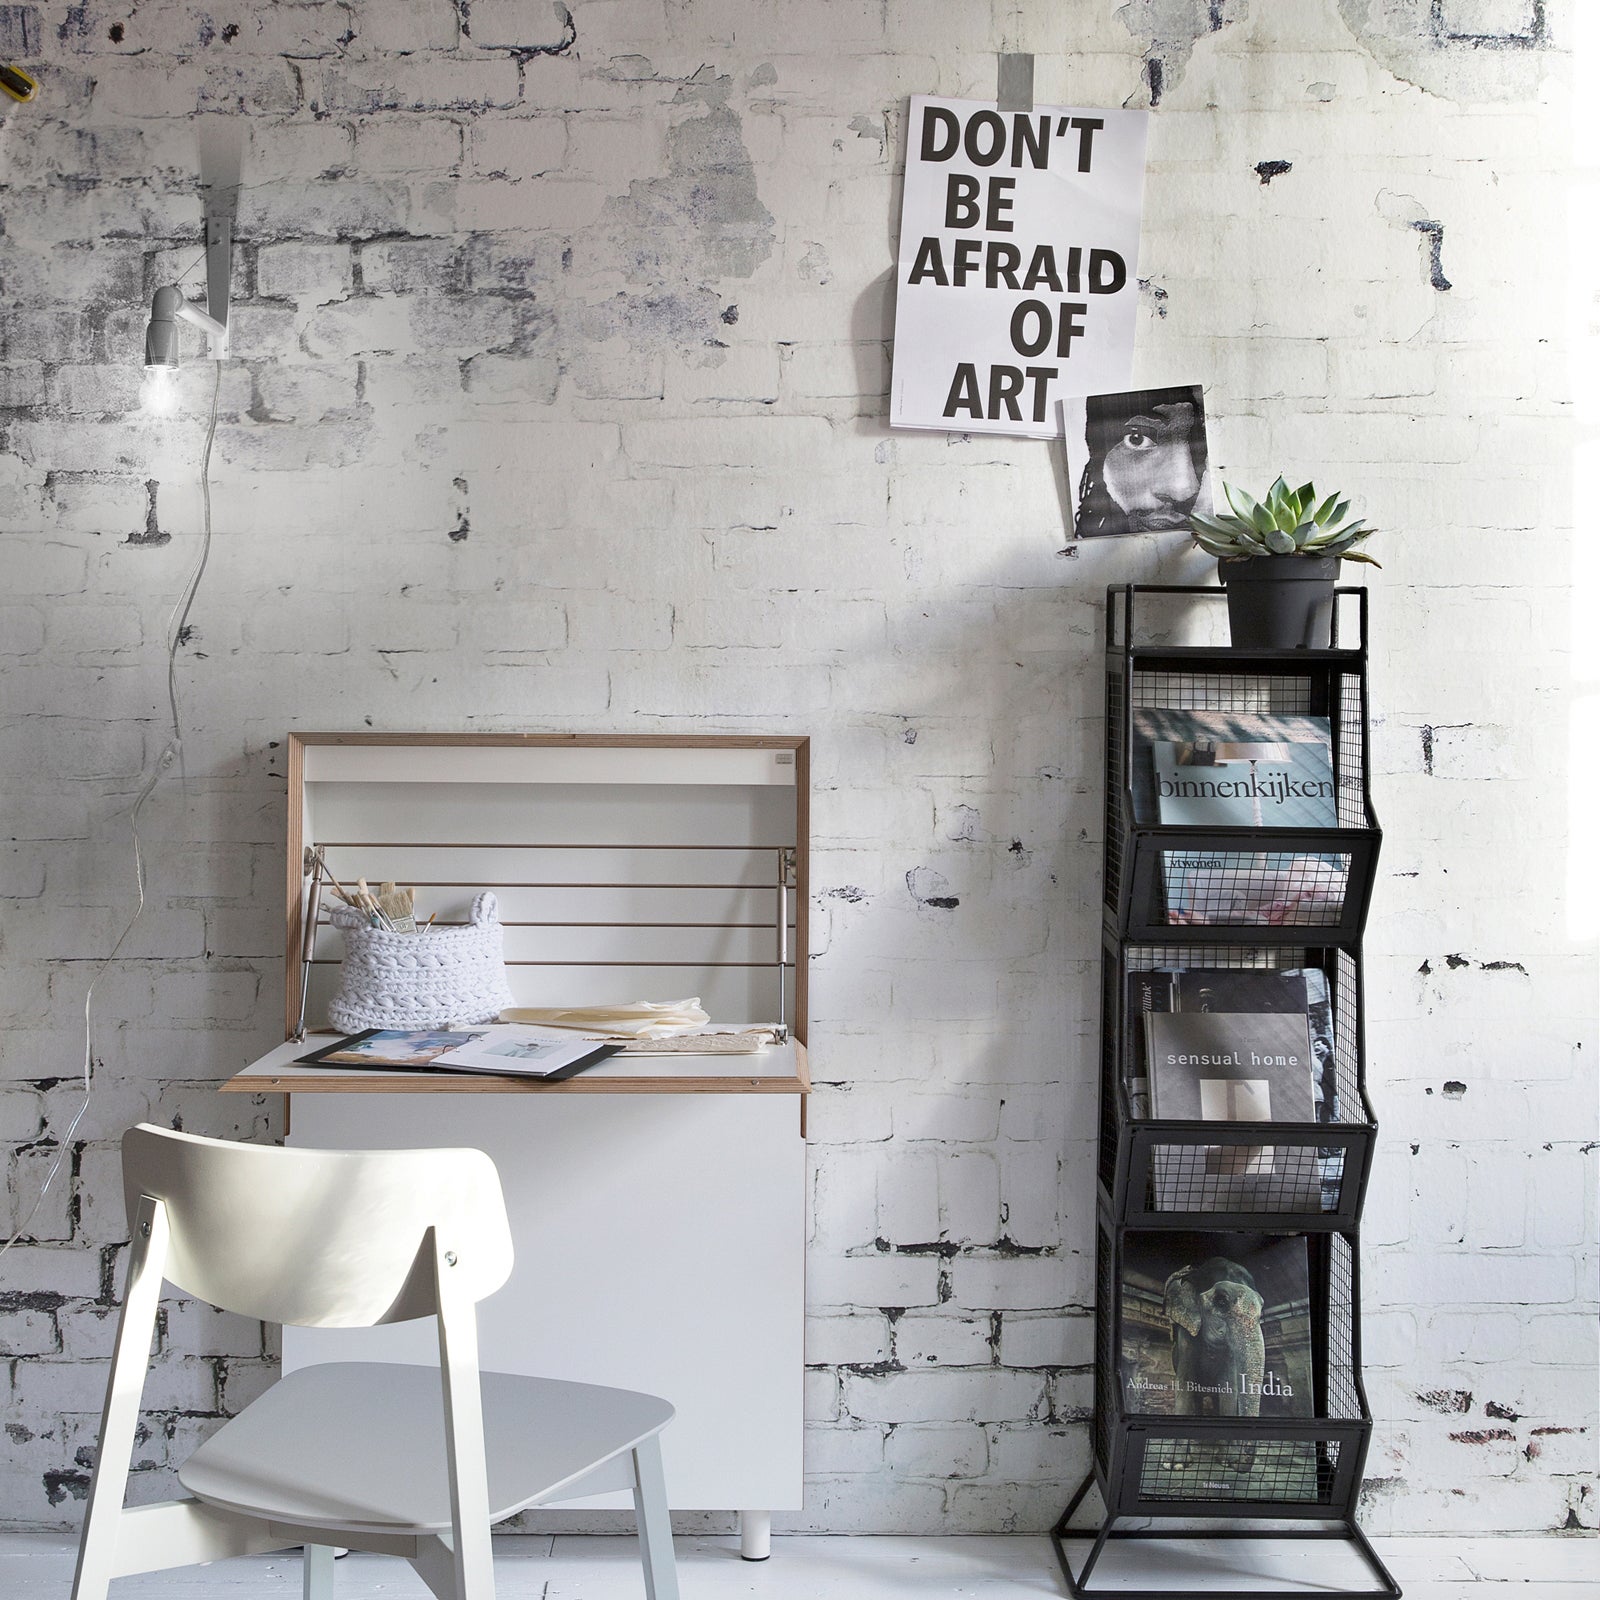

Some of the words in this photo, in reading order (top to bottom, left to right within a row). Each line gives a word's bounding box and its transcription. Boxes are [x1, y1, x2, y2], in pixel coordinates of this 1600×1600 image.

[920, 106, 1104, 173] DON'T
[944, 173, 1016, 232] BE
[908, 237, 1127, 294] AFRAID
[1010, 299, 1087, 358] OF
[942, 362, 1059, 423] ART
[1156, 772, 1334, 804] binnenkijken
[1170, 859, 1221, 869] vtwonen
[1167, 1052, 1241, 1066] sensual
[1251, 1052, 1298, 1066] home
[1126, 1377, 1168, 1391] Andreas
[1171, 1380, 1183, 1392] H.
[1186, 1381, 1233, 1394] Bitesnich
[1239, 1371, 1294, 1397] India
